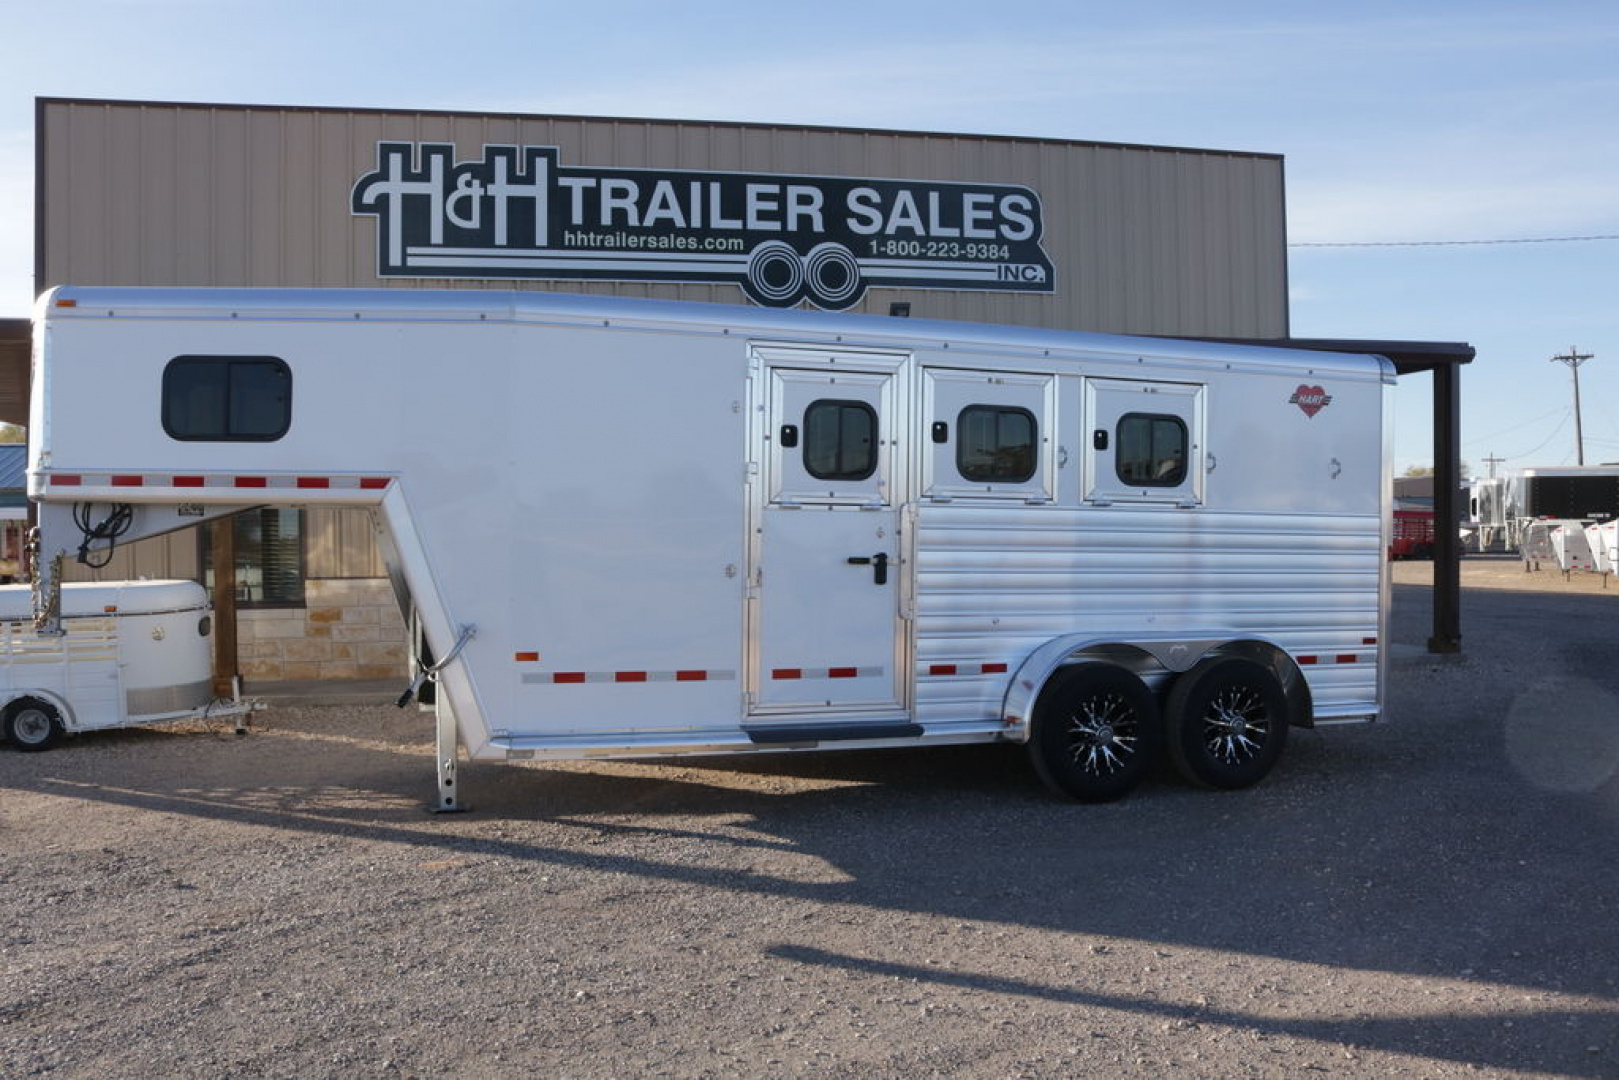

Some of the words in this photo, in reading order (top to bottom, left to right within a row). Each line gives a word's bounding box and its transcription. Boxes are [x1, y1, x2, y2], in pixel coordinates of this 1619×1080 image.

[361, 153, 548, 266] H&H
[558, 177, 824, 233] TRAILER
[846, 187, 1035, 241] SALES
[564, 230, 744, 250] hhtrailersales.com
[869, 240, 1010, 260] 1-800-223-9384
[997, 265, 1045, 282] INC.
